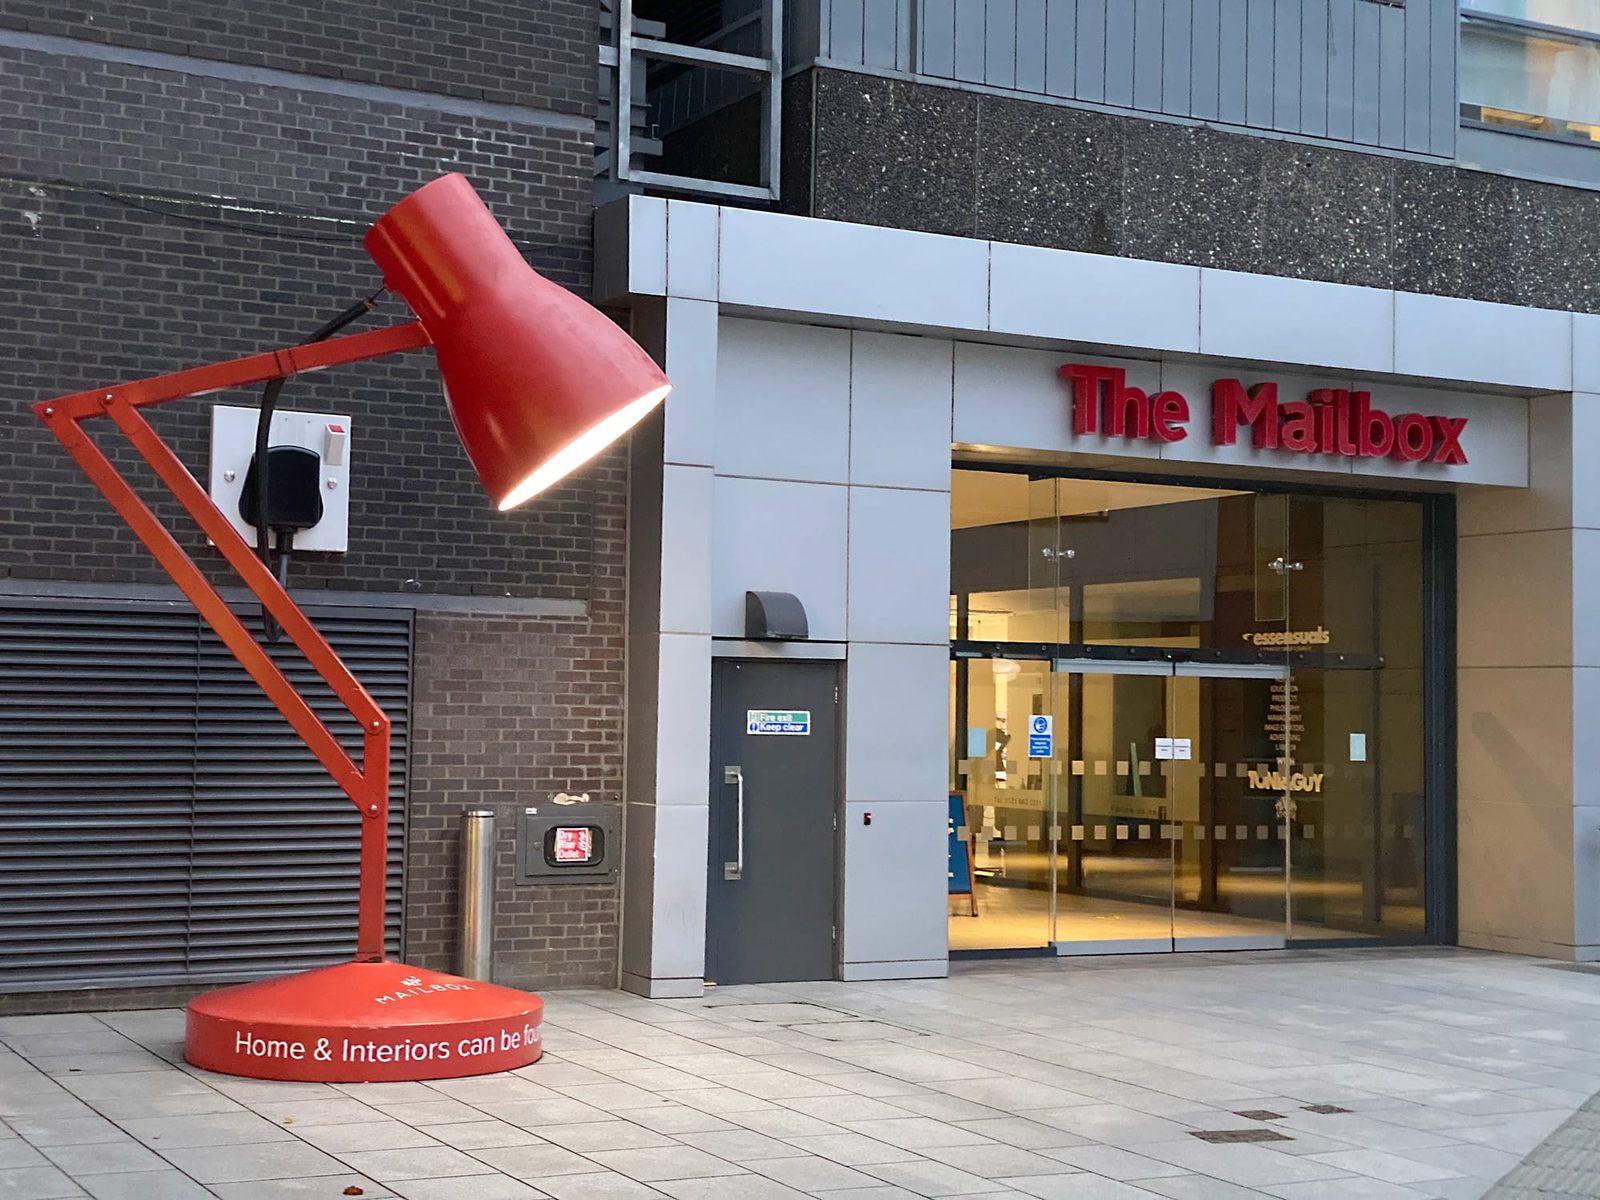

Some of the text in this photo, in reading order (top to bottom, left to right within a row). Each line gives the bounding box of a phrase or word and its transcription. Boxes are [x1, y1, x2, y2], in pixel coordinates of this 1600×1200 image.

[1059, 363, 1469, 465] The Mailbox
[760, 713, 793, 721] Fire exit
[760, 721, 804, 732] Keep clear
[374, 983, 476, 1005] MAILBOX
[235, 1023, 543, 1063] Home & Interiors can be fou
